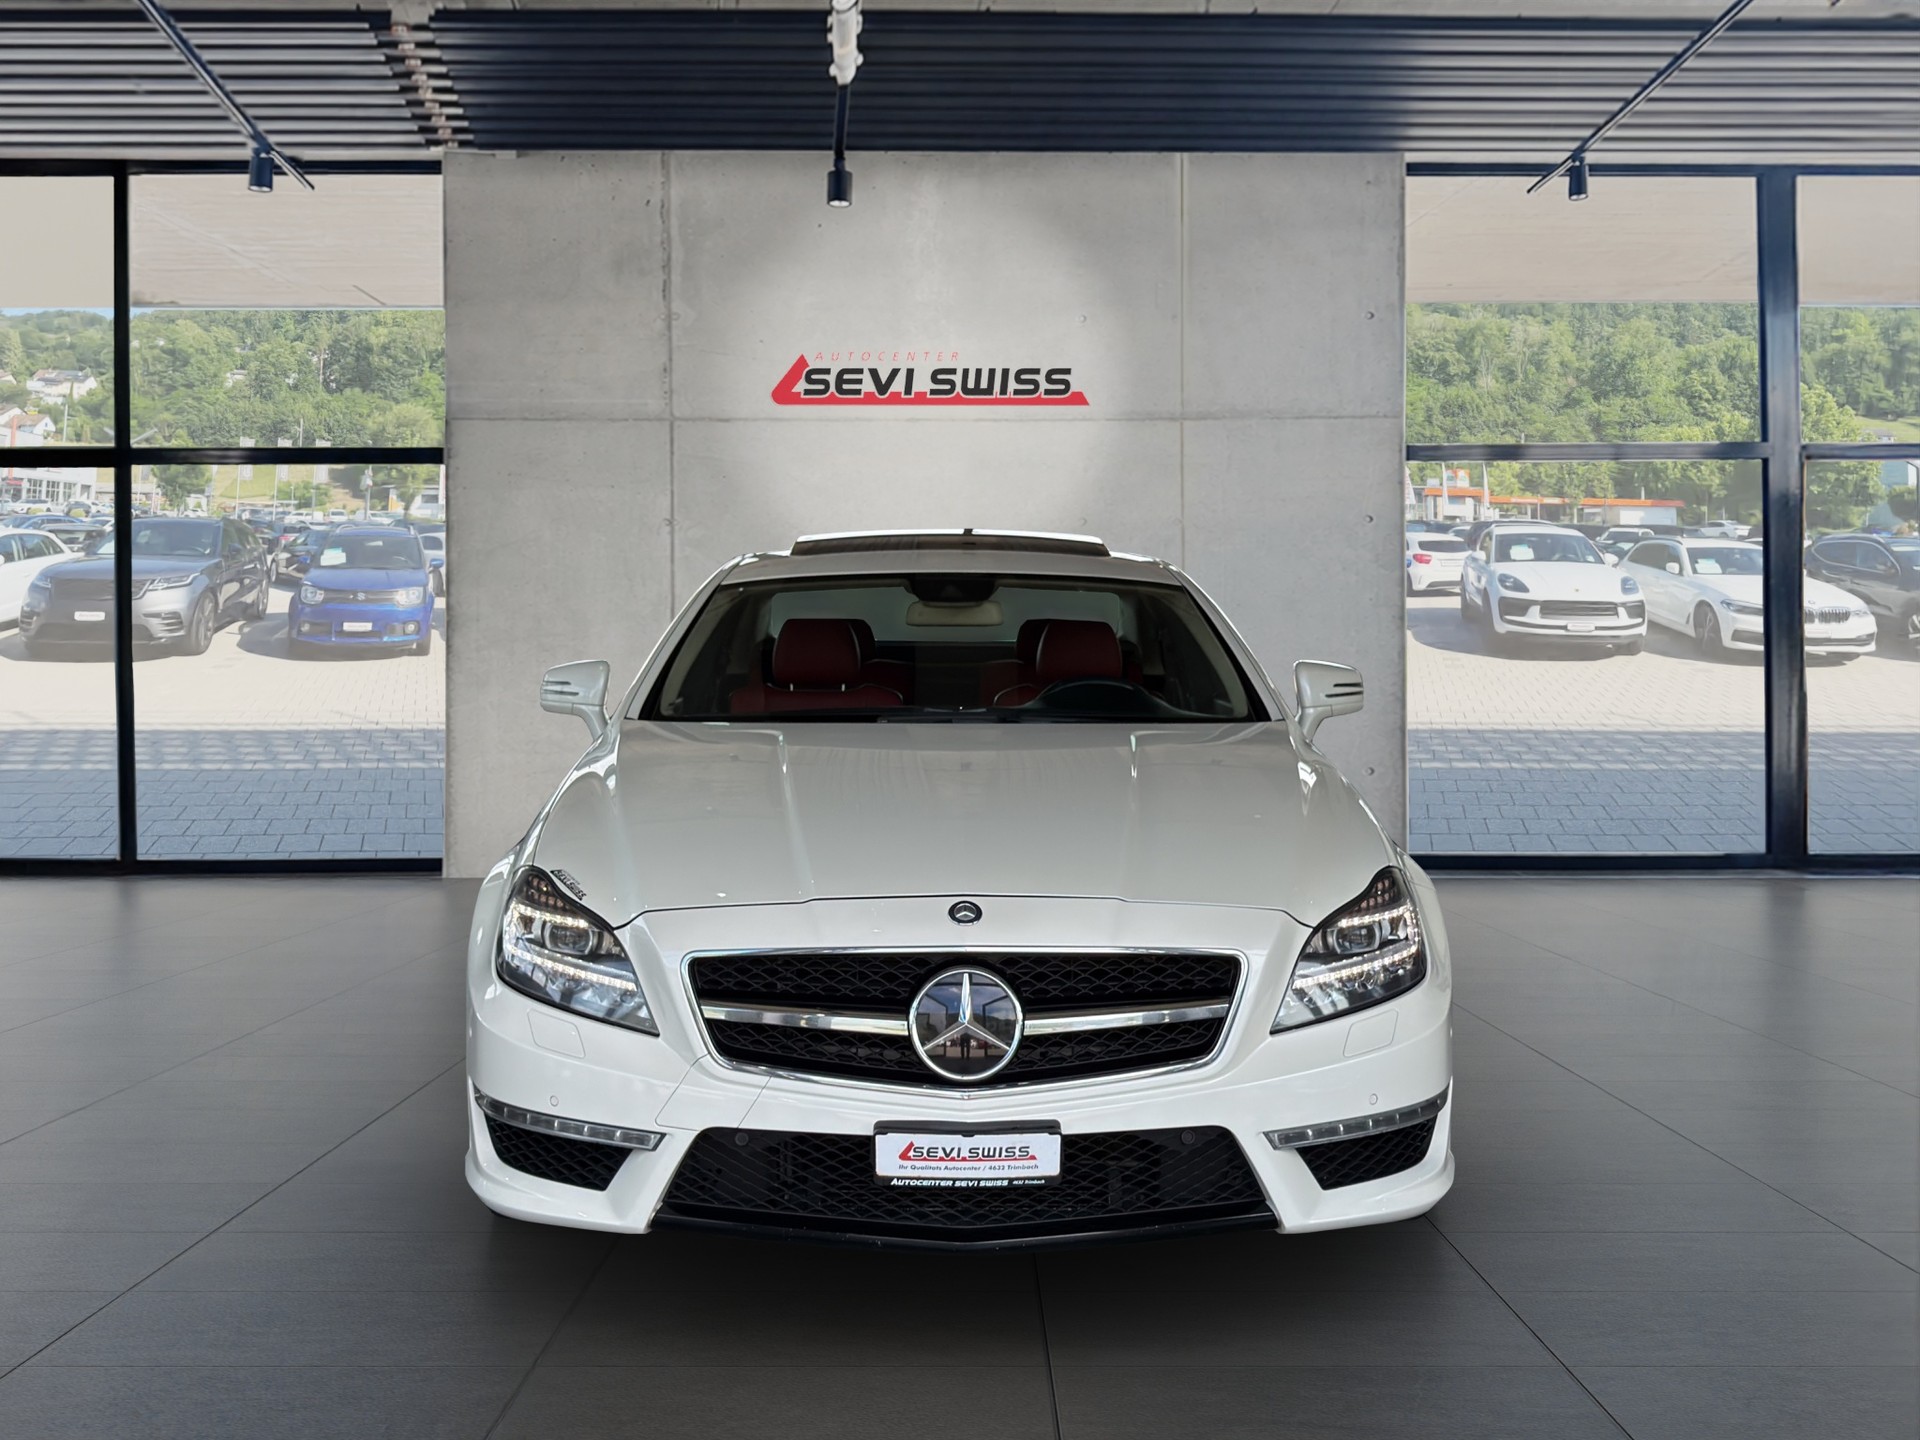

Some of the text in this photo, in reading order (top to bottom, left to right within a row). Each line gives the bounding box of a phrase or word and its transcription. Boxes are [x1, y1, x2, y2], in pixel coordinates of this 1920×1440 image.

[814, 351, 960, 362] AUTOCENTER
[803, 368, 1072, 396] SEVI SWISS
[912, 1145, 1030, 1159] SEVI SWISS
[1007, 1163, 1039, 1171] Trimbach
[979, 1179, 1009, 1187] SWISS
